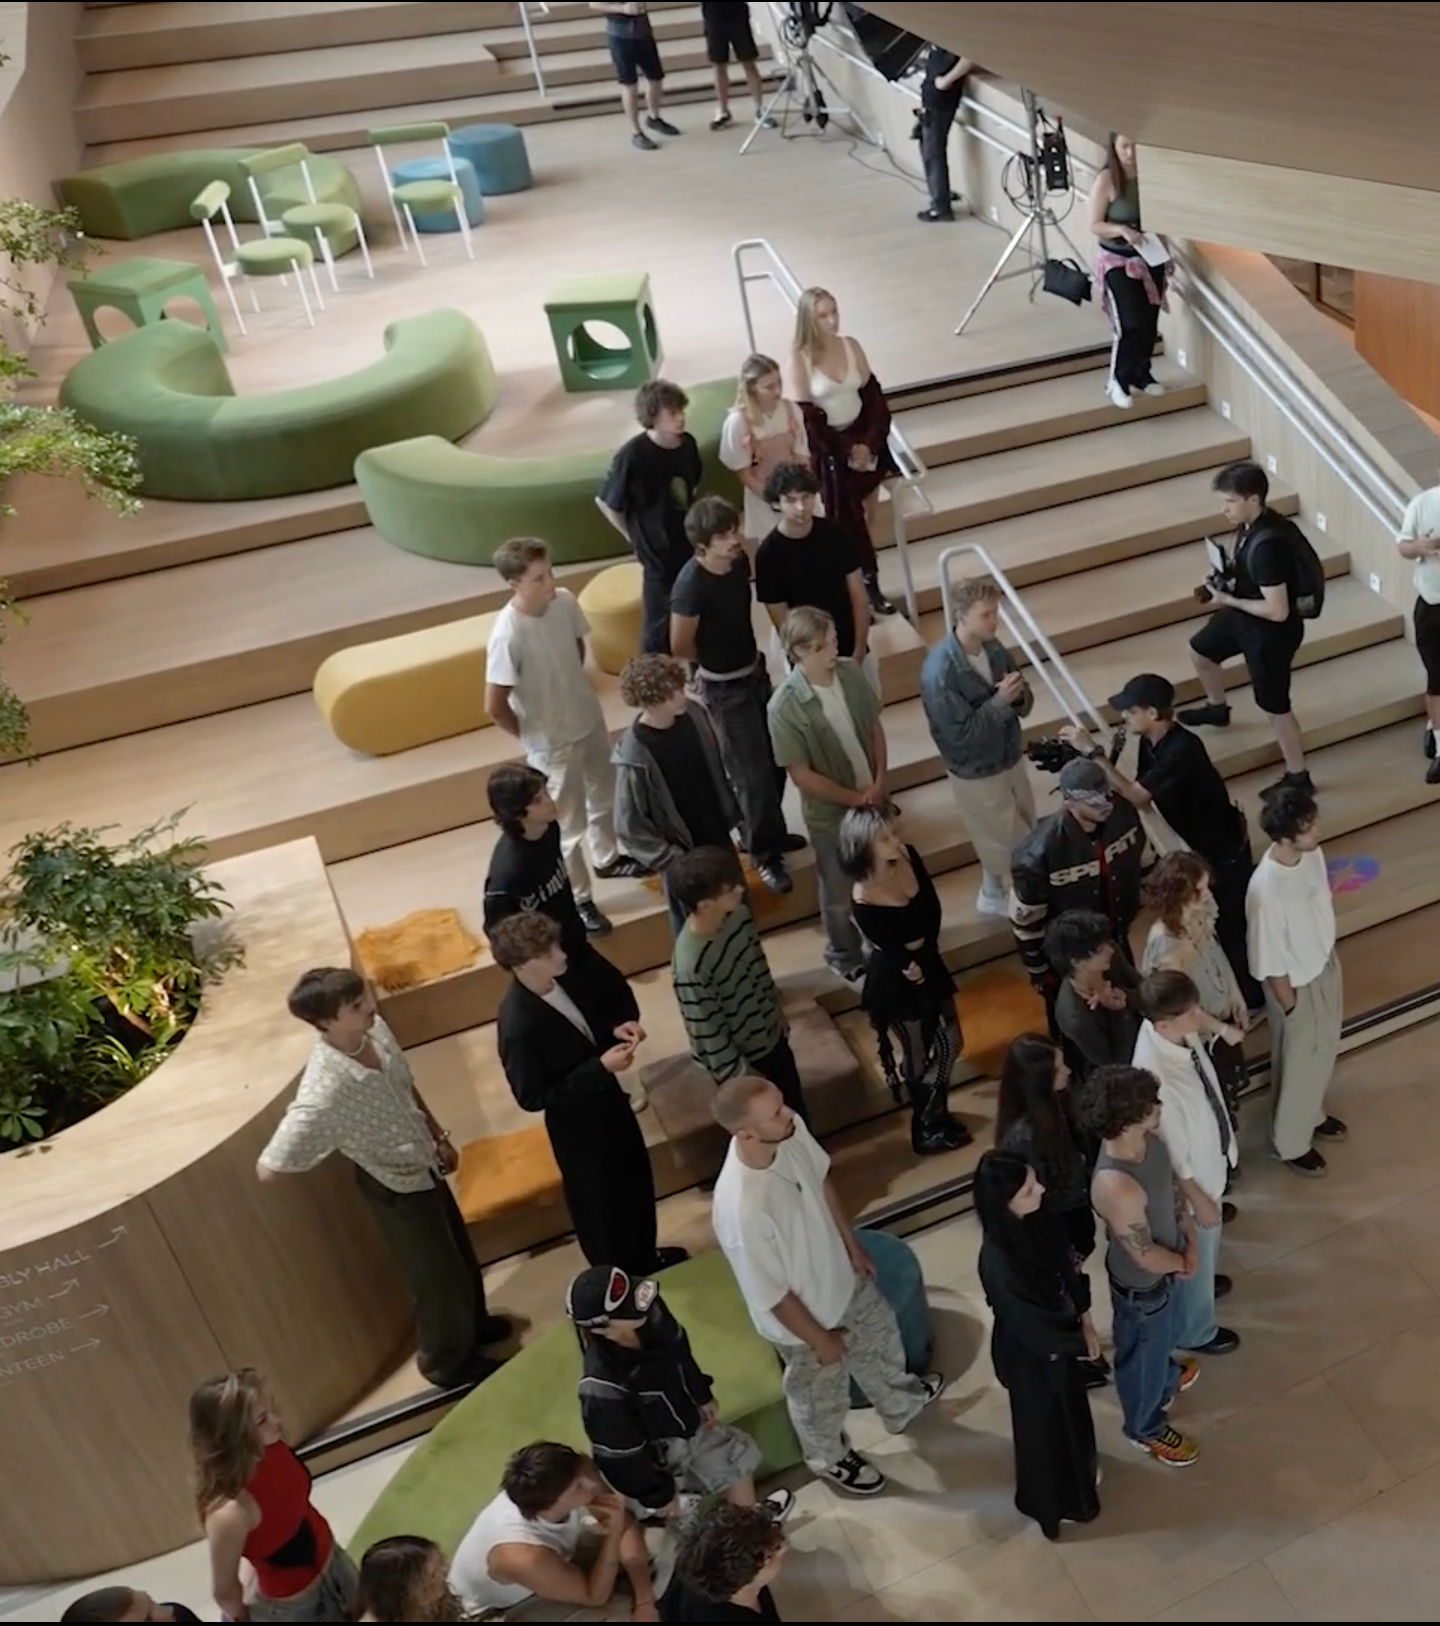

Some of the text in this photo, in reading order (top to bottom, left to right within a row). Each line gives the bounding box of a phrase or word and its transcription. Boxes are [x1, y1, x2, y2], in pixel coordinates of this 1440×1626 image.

[35, 1250, 92, 1277] HALL
[0, 1297, 43, 1319] GYM
[0, 1316, 73, 1349] DROBE
